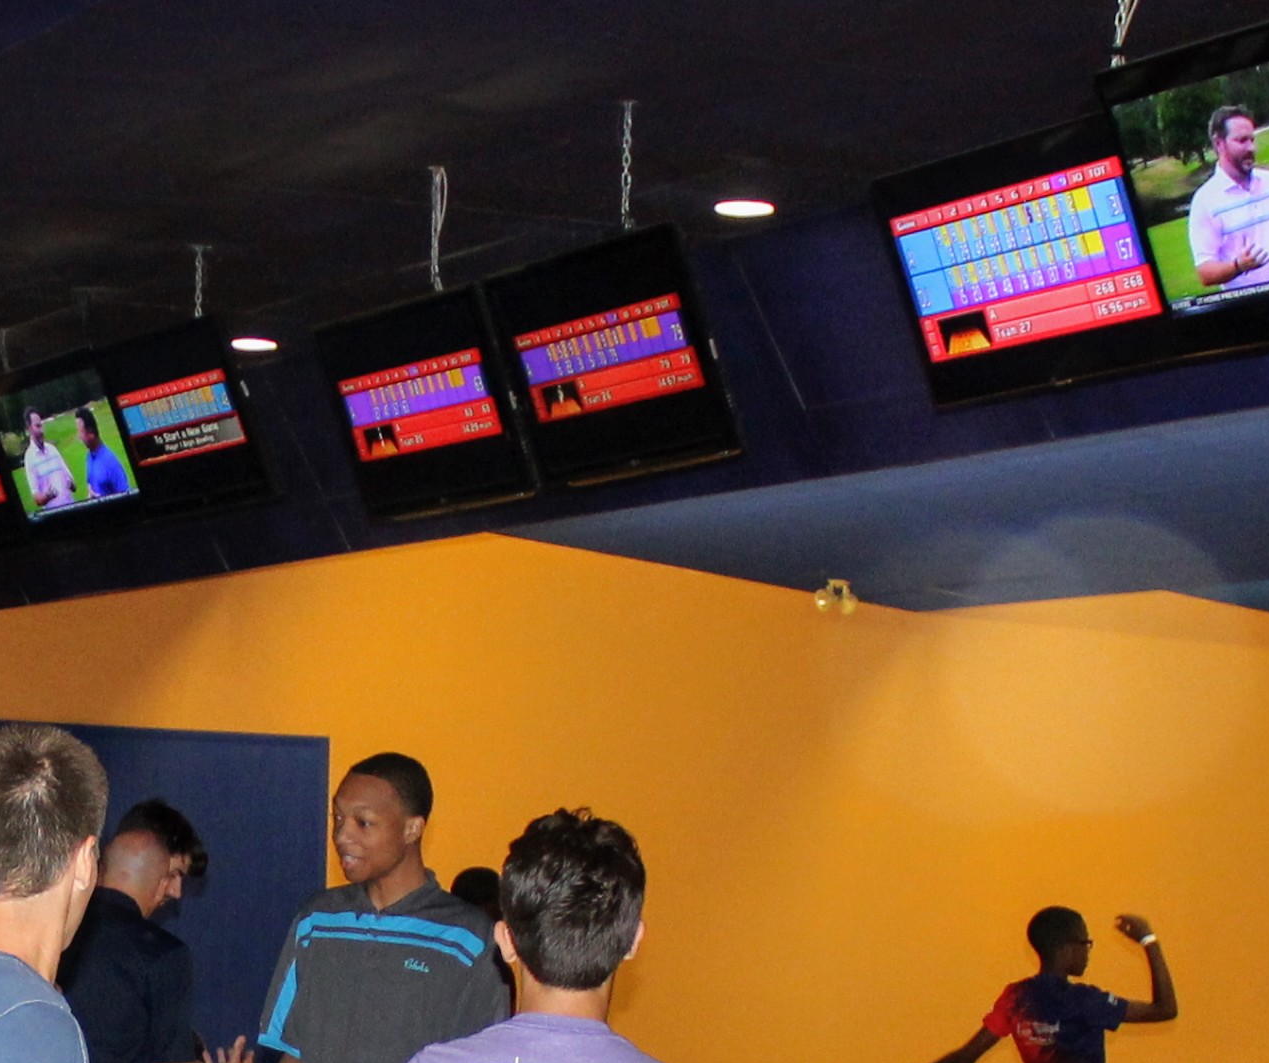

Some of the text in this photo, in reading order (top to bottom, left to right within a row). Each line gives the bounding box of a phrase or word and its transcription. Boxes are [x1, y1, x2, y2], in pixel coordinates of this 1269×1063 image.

[1094, 282, 1114, 294] 268
[1122, 275, 1143, 288] 268
[1018, 321, 1032, 332] 27
